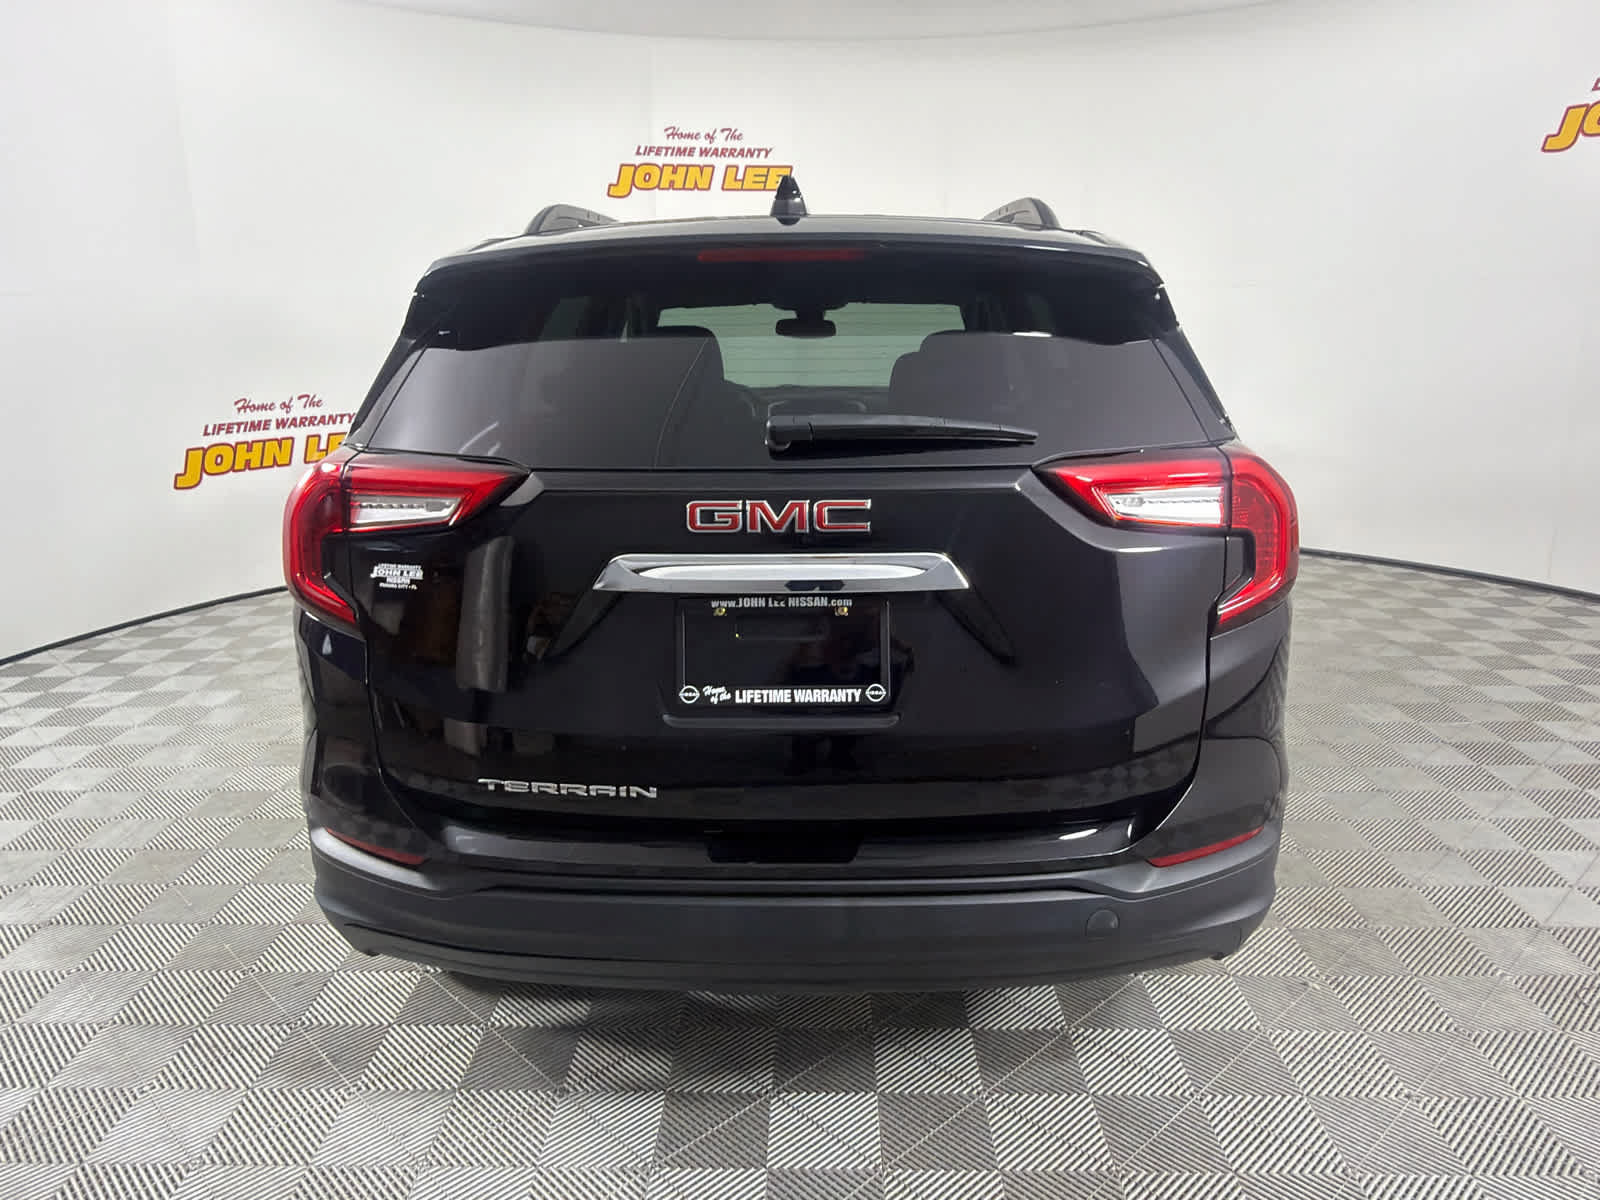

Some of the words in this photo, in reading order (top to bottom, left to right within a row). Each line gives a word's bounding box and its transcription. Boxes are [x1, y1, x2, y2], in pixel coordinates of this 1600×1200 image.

[664, 126, 700, 141] Home
[704, 128, 717, 144] of
[720, 128, 743, 141] The
[635, 145, 695, 157] LIFETIME
[699, 147, 772, 159] WARRANTY
[607, 163, 715, 198] JOHN
[721, 165, 793, 191] LEE
[234, 397, 276, 414] Home
[279, 399, 293, 414] of
[297, 394, 323, 409] The
[203, 419, 272, 436] LIFETIME
[275, 412, 356, 430] WARRANTY
[174, 436, 294, 490] JOHN
[686, 499, 871, 533] GMC
[370, 566, 401, 578] JOHN
[711, 597, 765, 608] www.JOHN
[788, 596, 852, 607] NISSAN.com
[735, 689, 792, 703] LIFETIME
[794, 688, 861, 703] WARRANTY
[478, 778, 657, 798] TERRAIN
